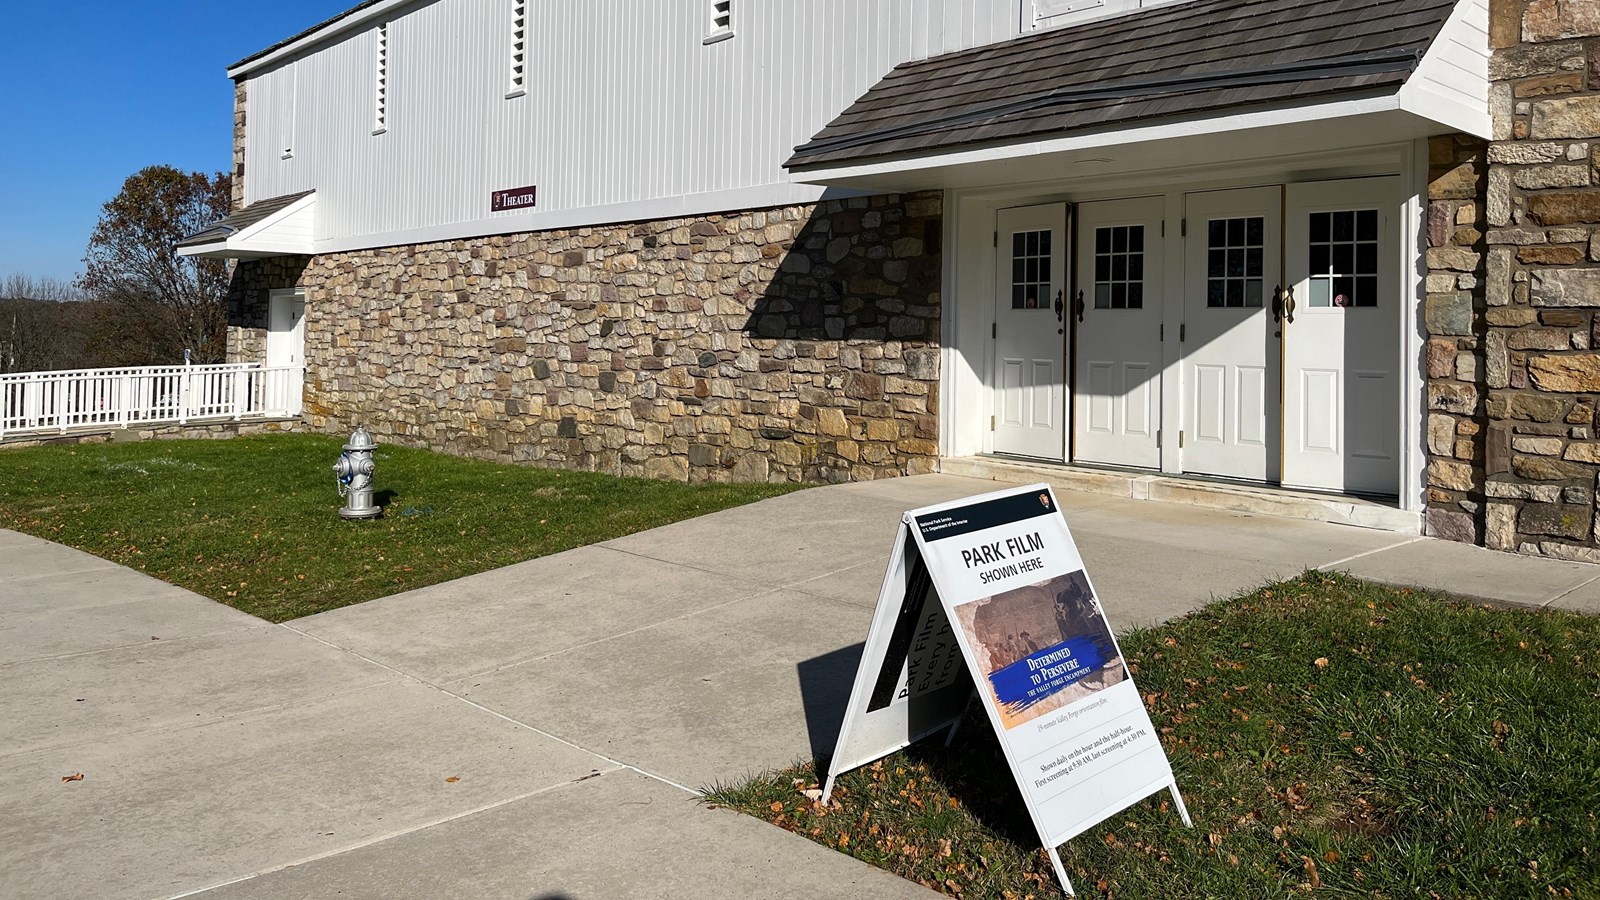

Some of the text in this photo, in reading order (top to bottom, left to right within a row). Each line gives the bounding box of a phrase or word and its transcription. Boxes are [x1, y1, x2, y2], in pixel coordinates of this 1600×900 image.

[502, 193, 534, 207] THEATER
[961, 532, 1044, 568] PARK FILM
[980, 557, 1044, 584] SHOWN HERE
[898, 657, 922, 699] Park
[914, 612, 938, 652] Film
[917, 642, 946, 692] Every
[1026, 647, 1070, 672] DETERMINED
[1040, 658, 1080, 681] PERSEVERE
[1027, 666, 1092, 698] THE VALLEY FORGE ENCAMPMENT
[1056, 714, 1068, 724] Valley
[1068, 710, 1079, 719] Forge
[1079, 702, 1099, 714] orientation
[1035, 778, 1047, 788] First
[1046, 768, 1069, 782] screening
[1091, 751, 1101, 760] last
[1101, 741, 1123, 755] screening
[1040, 762, 1057, 773] Shown
[1056, 755, 1068, 766] daily
[1081, 744, 1093, 753] hour
[1093, 737, 1103, 747] and
[1102, 735, 1110, 744] the
